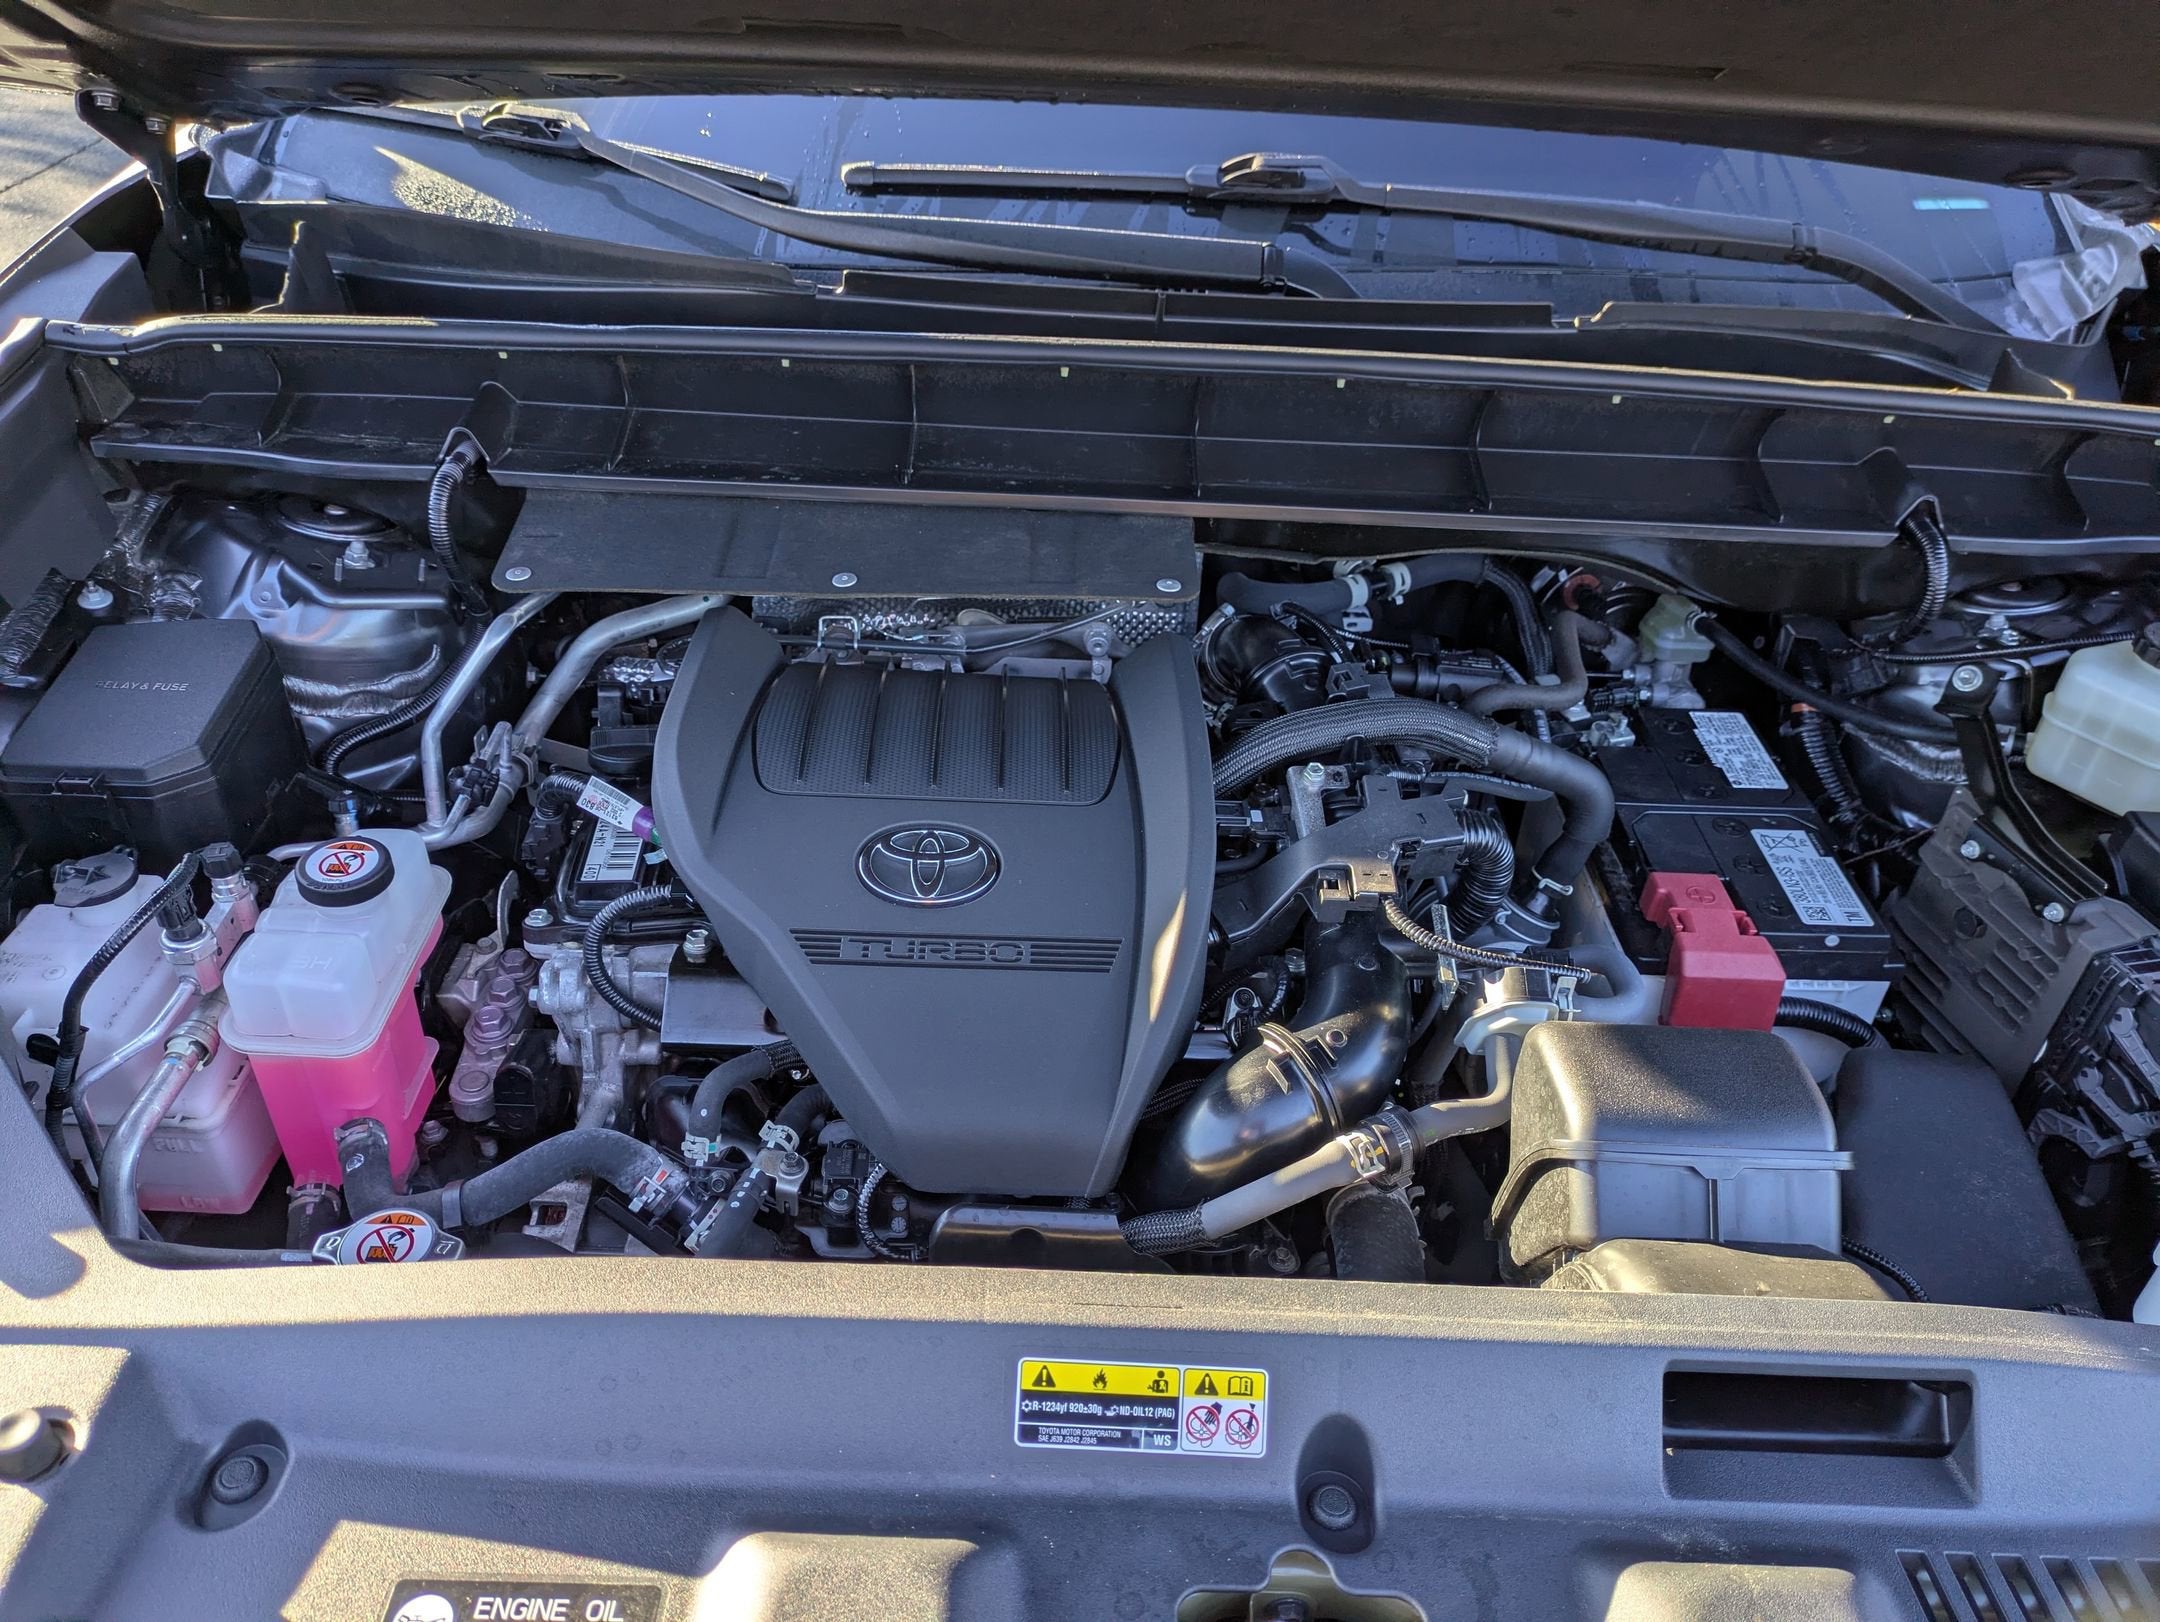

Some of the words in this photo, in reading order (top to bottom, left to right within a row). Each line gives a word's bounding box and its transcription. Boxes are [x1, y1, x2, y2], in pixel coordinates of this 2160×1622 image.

[95, 680, 140, 690] RELAY
[140, 681, 149, 690] &
[152, 681, 190, 692] FUSE
[848, 936, 1024, 963] TURBO
[1032, 1401, 1068, 1414] R-1234yf
[1119, 1405, 1153, 1417] ND-OIL12
[1154, 1407, 1175, 1420] (PAG)
[1038, 1427, 1060, 1435] TOYOTA
[1060, 1428, 1081, 1436] MOTOR
[1082, 1429, 1121, 1438] CORPORATION
[1153, 1434, 1172, 1446] WS
[473, 1596, 570, 1621] ENGINE
[585, 1599, 624, 1622] OIL
